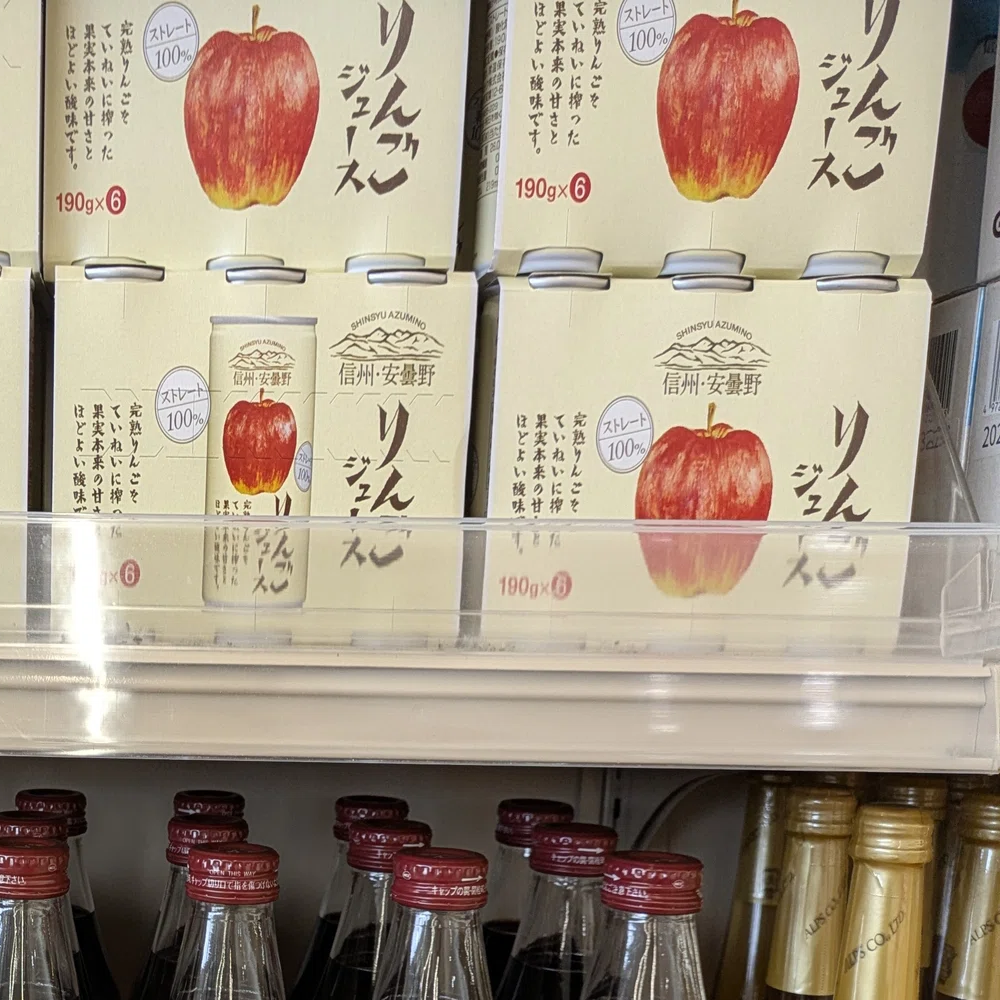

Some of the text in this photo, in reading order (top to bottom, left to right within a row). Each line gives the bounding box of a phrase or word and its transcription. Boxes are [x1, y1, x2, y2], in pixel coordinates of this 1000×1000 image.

[622, 2, 670, 25] ストレート
[148, 19, 193, 43] ストレート
[627, 26, 669, 54] 100%
[154, 44, 192, 69] 100%
[119, 19, 134, 126] 完熟りんごを
[83, 24, 96, 161] 果実本来の甘さと
[371, 2, 422, 195] りんご
[334, 64, 371, 197] ジュース
[807, 54, 849, 190] ジュース
[350, 310, 427, 331] SHINSYU AZUMINO
[675, 319, 753, 341] SHINSYU AZUMINO
[339, 362, 436, 388] 信州・安曇野
[662, 372, 763, 397] 信州・安曇野
[160, 384, 206, 406] ストレート
[166, 406, 204, 433] 100%
[602, 413, 648, 435] ストレート
[128, 401, 143, 504] 完熟りんごを
[570, 411, 587, 514] 完熟りんごを
[607, 437, 647, 463] 100%
